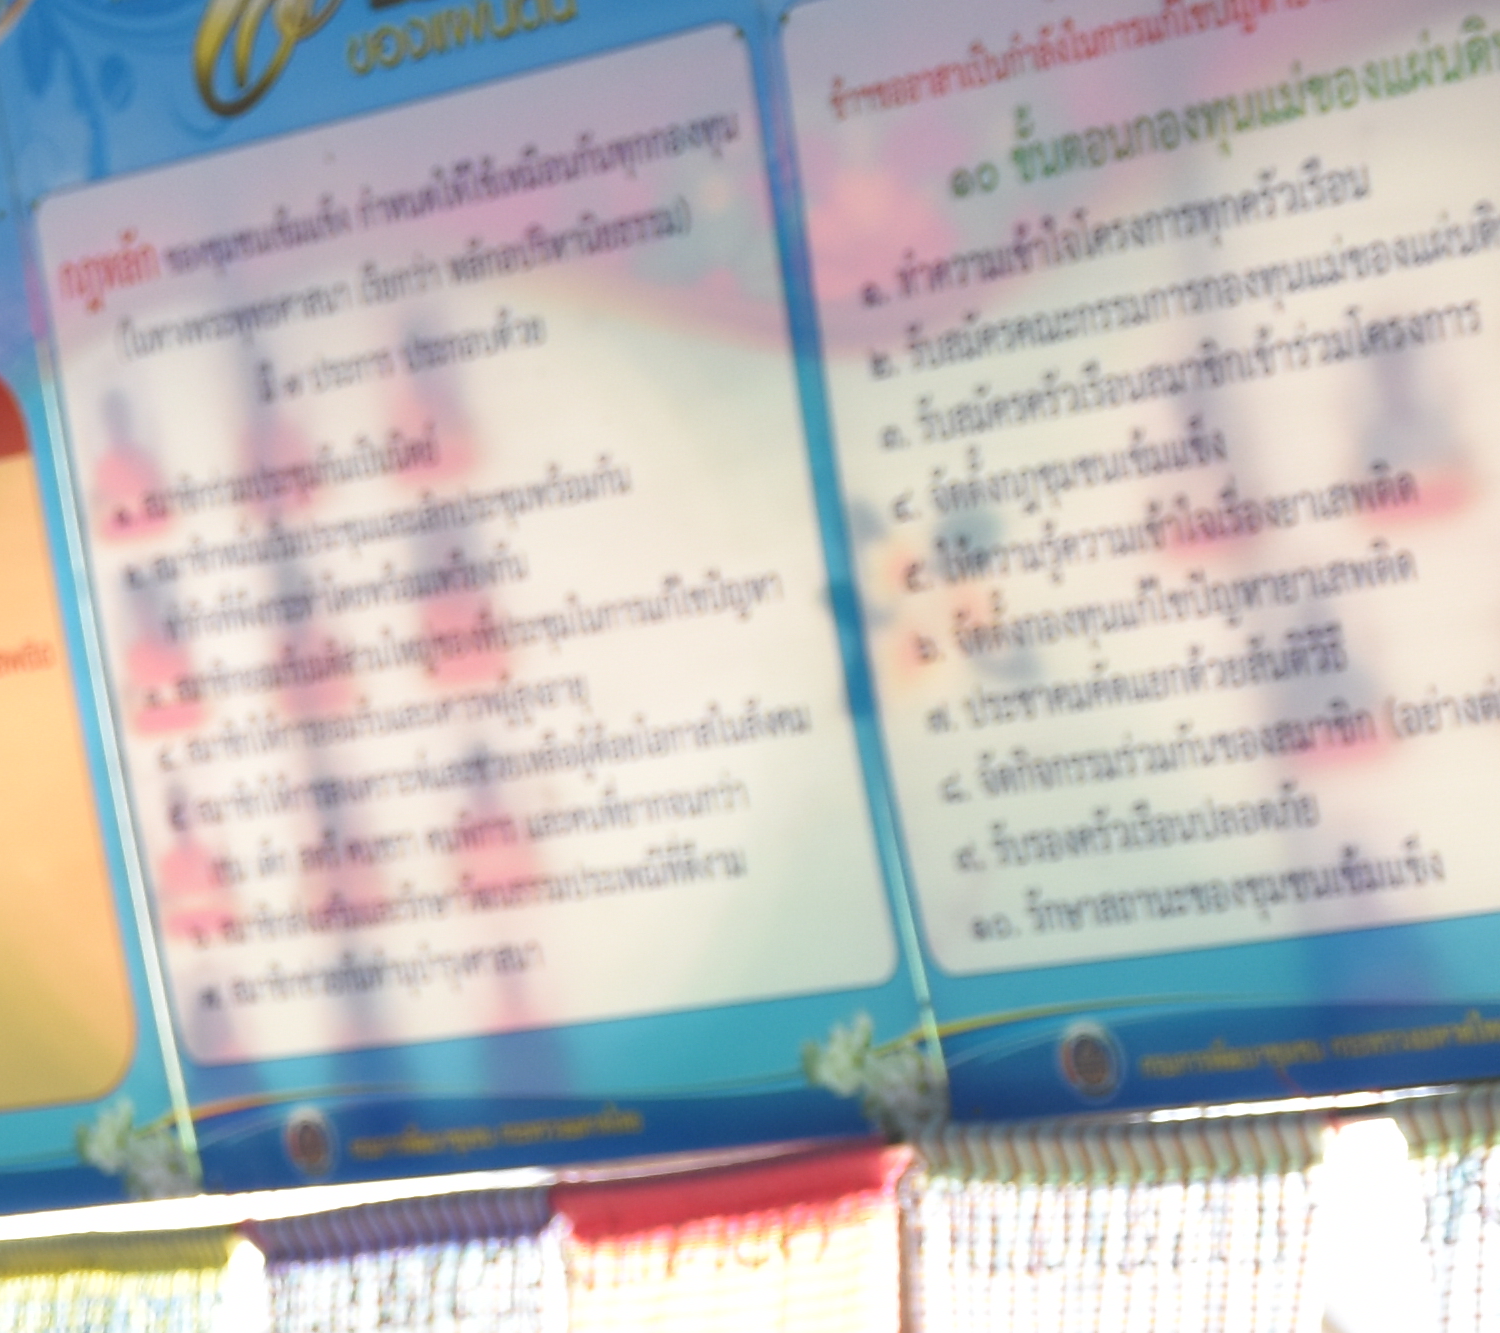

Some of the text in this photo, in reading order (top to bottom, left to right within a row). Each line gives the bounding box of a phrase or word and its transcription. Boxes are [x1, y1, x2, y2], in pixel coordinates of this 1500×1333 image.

[949, 14, 1500, 197] ๑๐ ขั้นตอนกองทุนแม่ของแผ่นดิ
